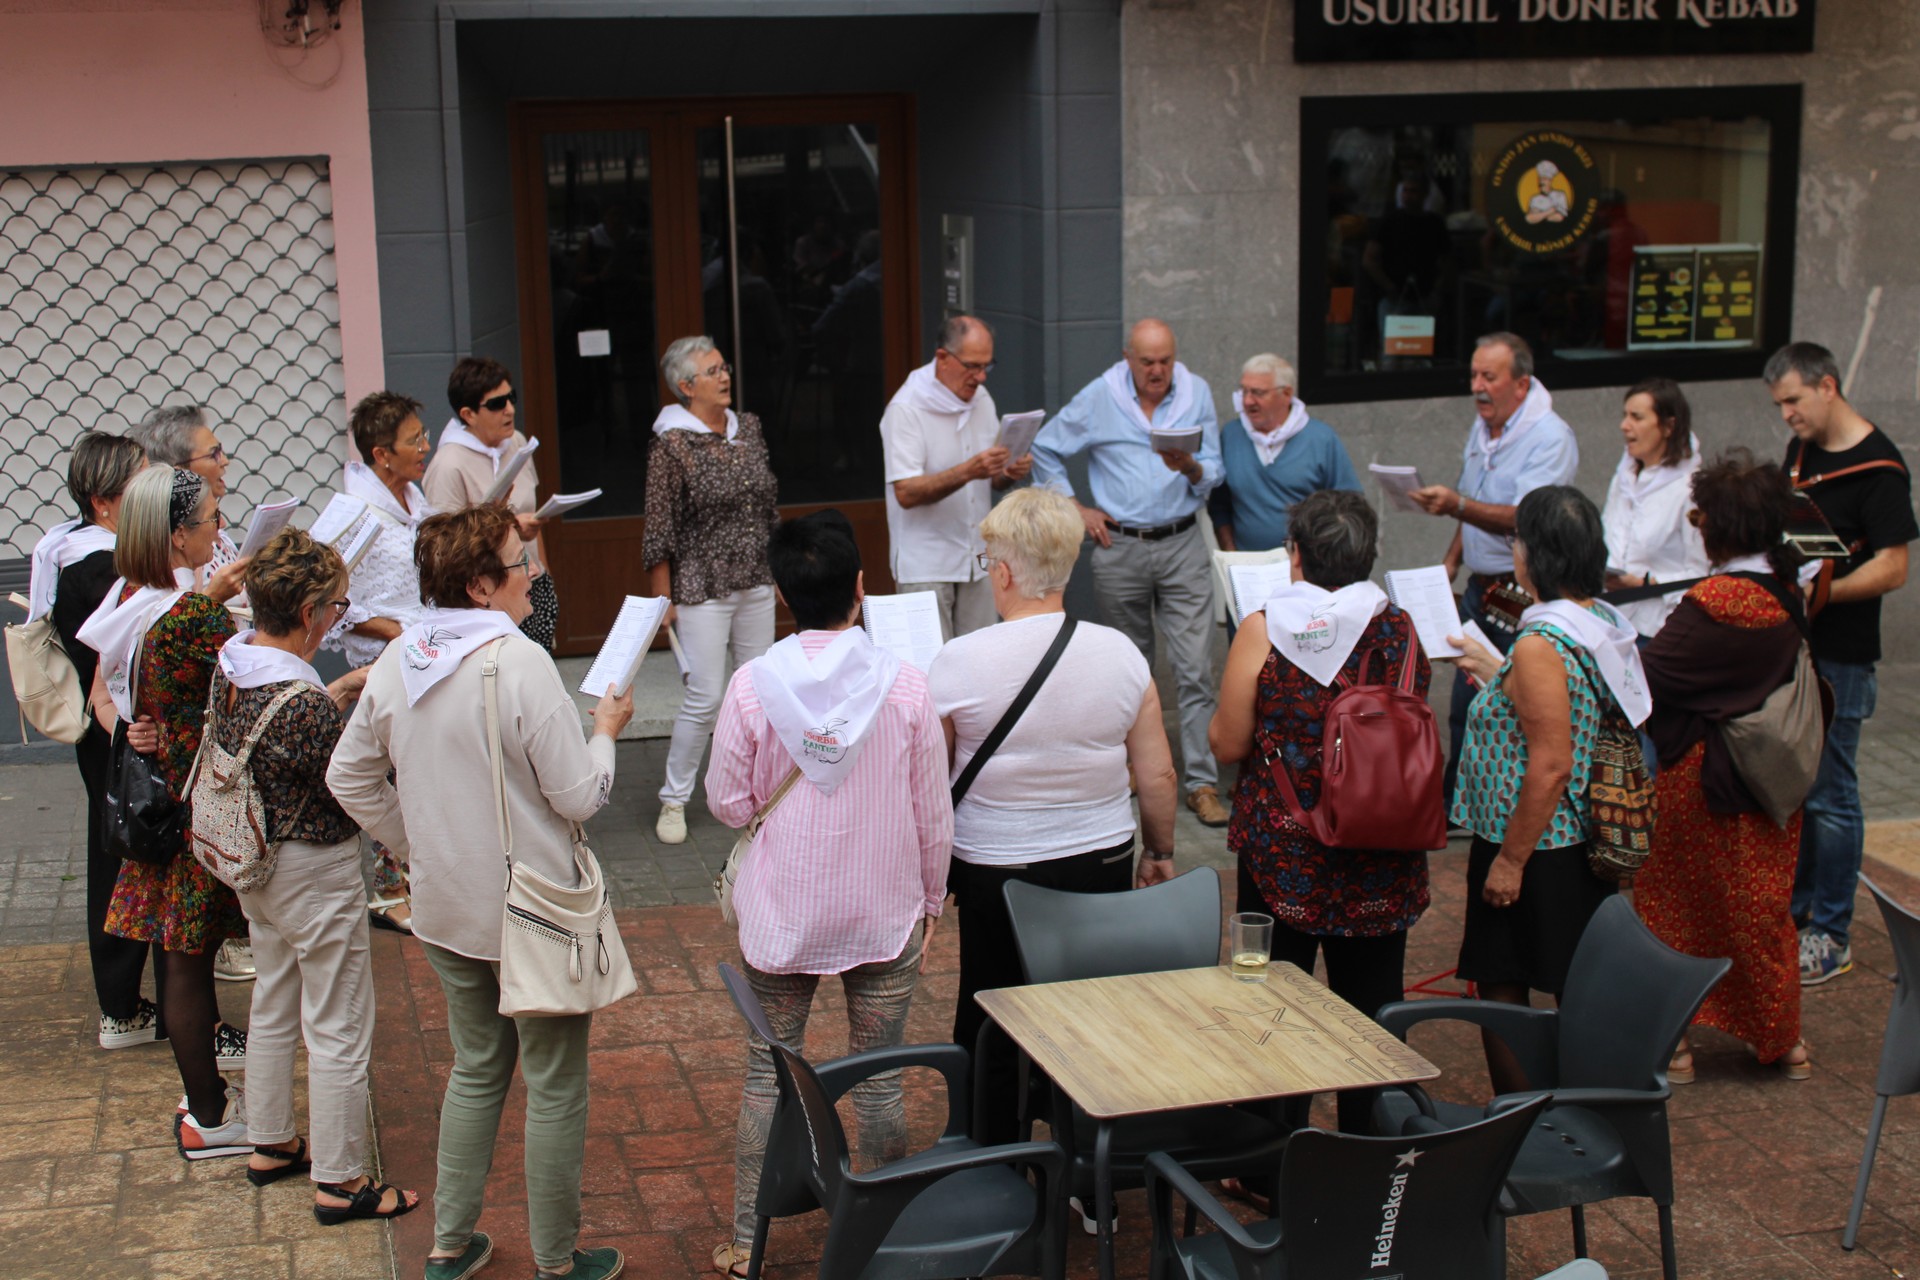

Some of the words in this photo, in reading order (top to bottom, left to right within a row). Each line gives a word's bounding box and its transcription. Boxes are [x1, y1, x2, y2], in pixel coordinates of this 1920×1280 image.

[1322, 0, 1499, 26] USURBIL
[1676, 0, 1799, 28] KEBAB
[802, 738, 838, 754] KANTUZ
[803, 730, 838, 745] USURBIL
[1370, 1172, 1409, 1269] Heineken
